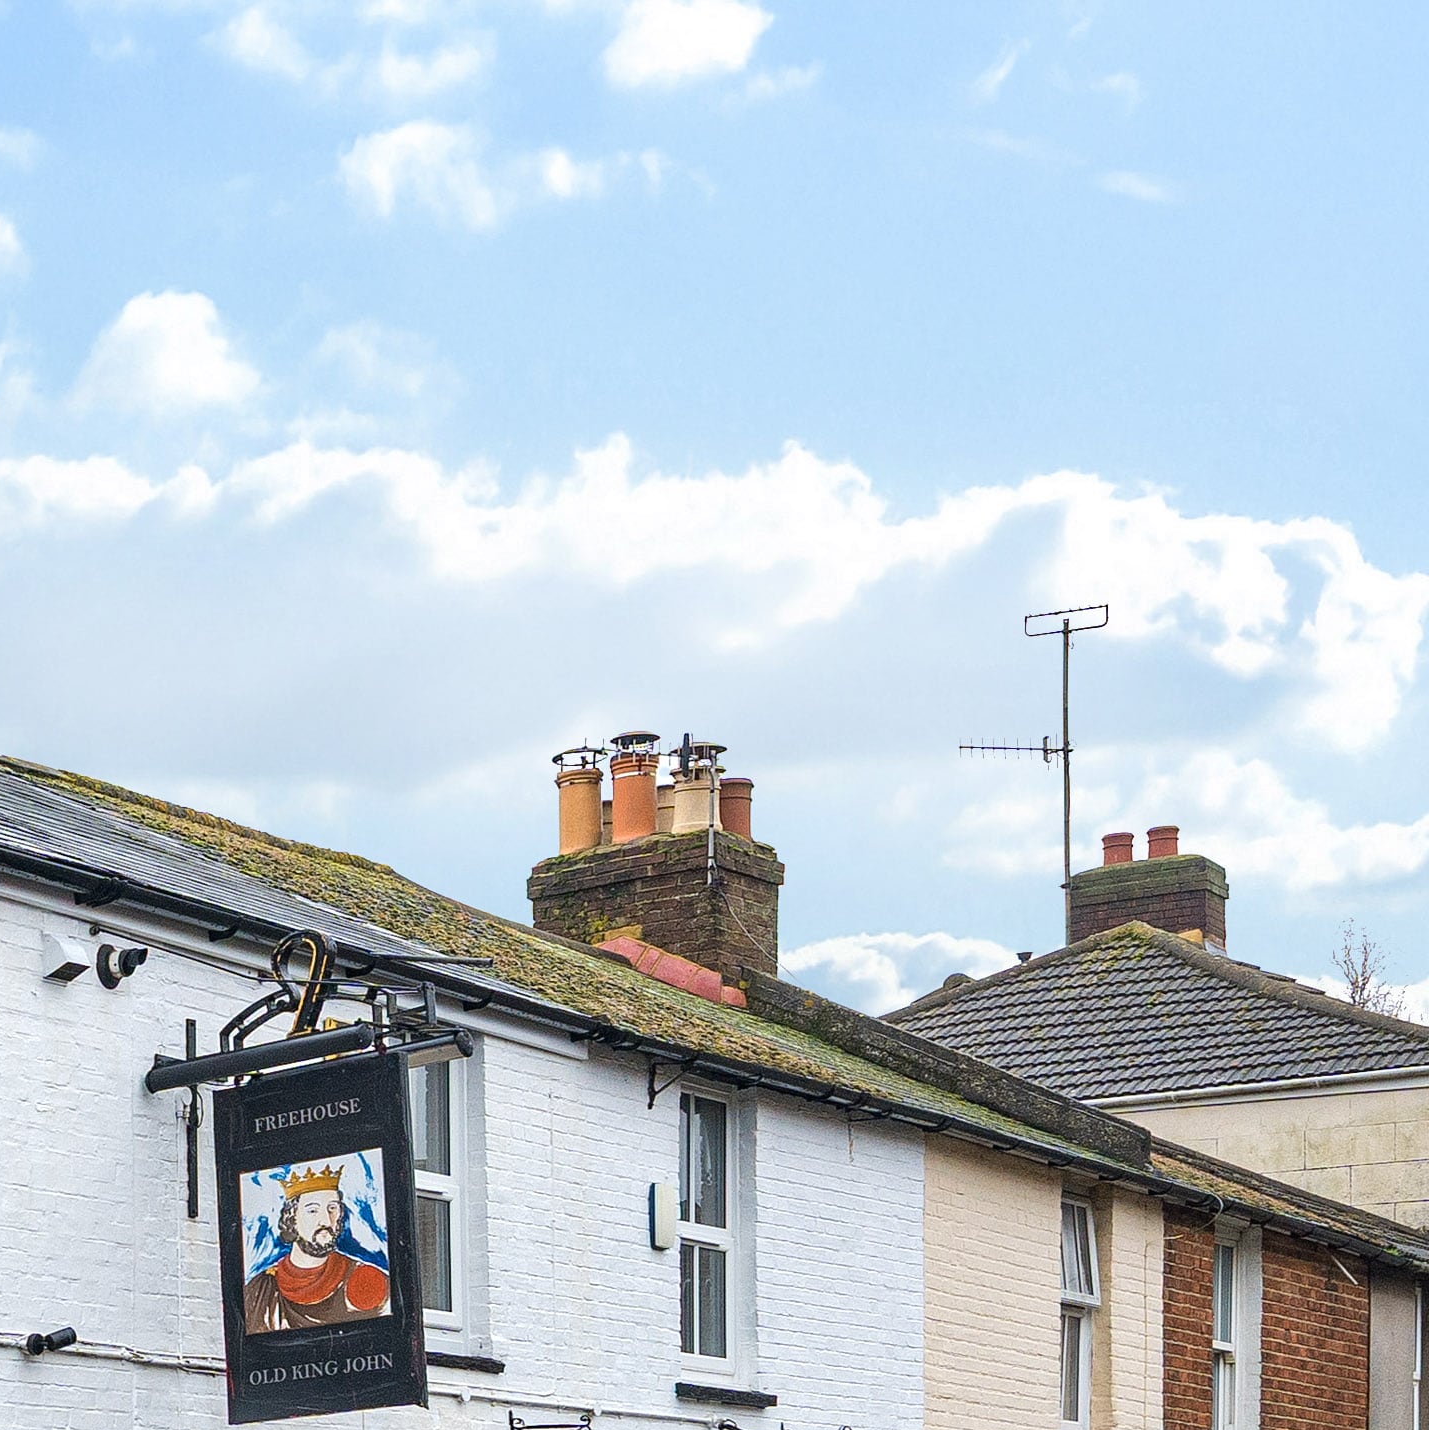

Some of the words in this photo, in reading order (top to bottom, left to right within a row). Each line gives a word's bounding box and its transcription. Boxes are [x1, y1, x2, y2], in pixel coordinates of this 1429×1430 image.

[253, 1097, 361, 1134] FREEHOUSE
[248, 1367, 287, 1386] OLD
[291, 1360, 339, 1381] KING
[342, 1353, 394, 1374] JOHN
